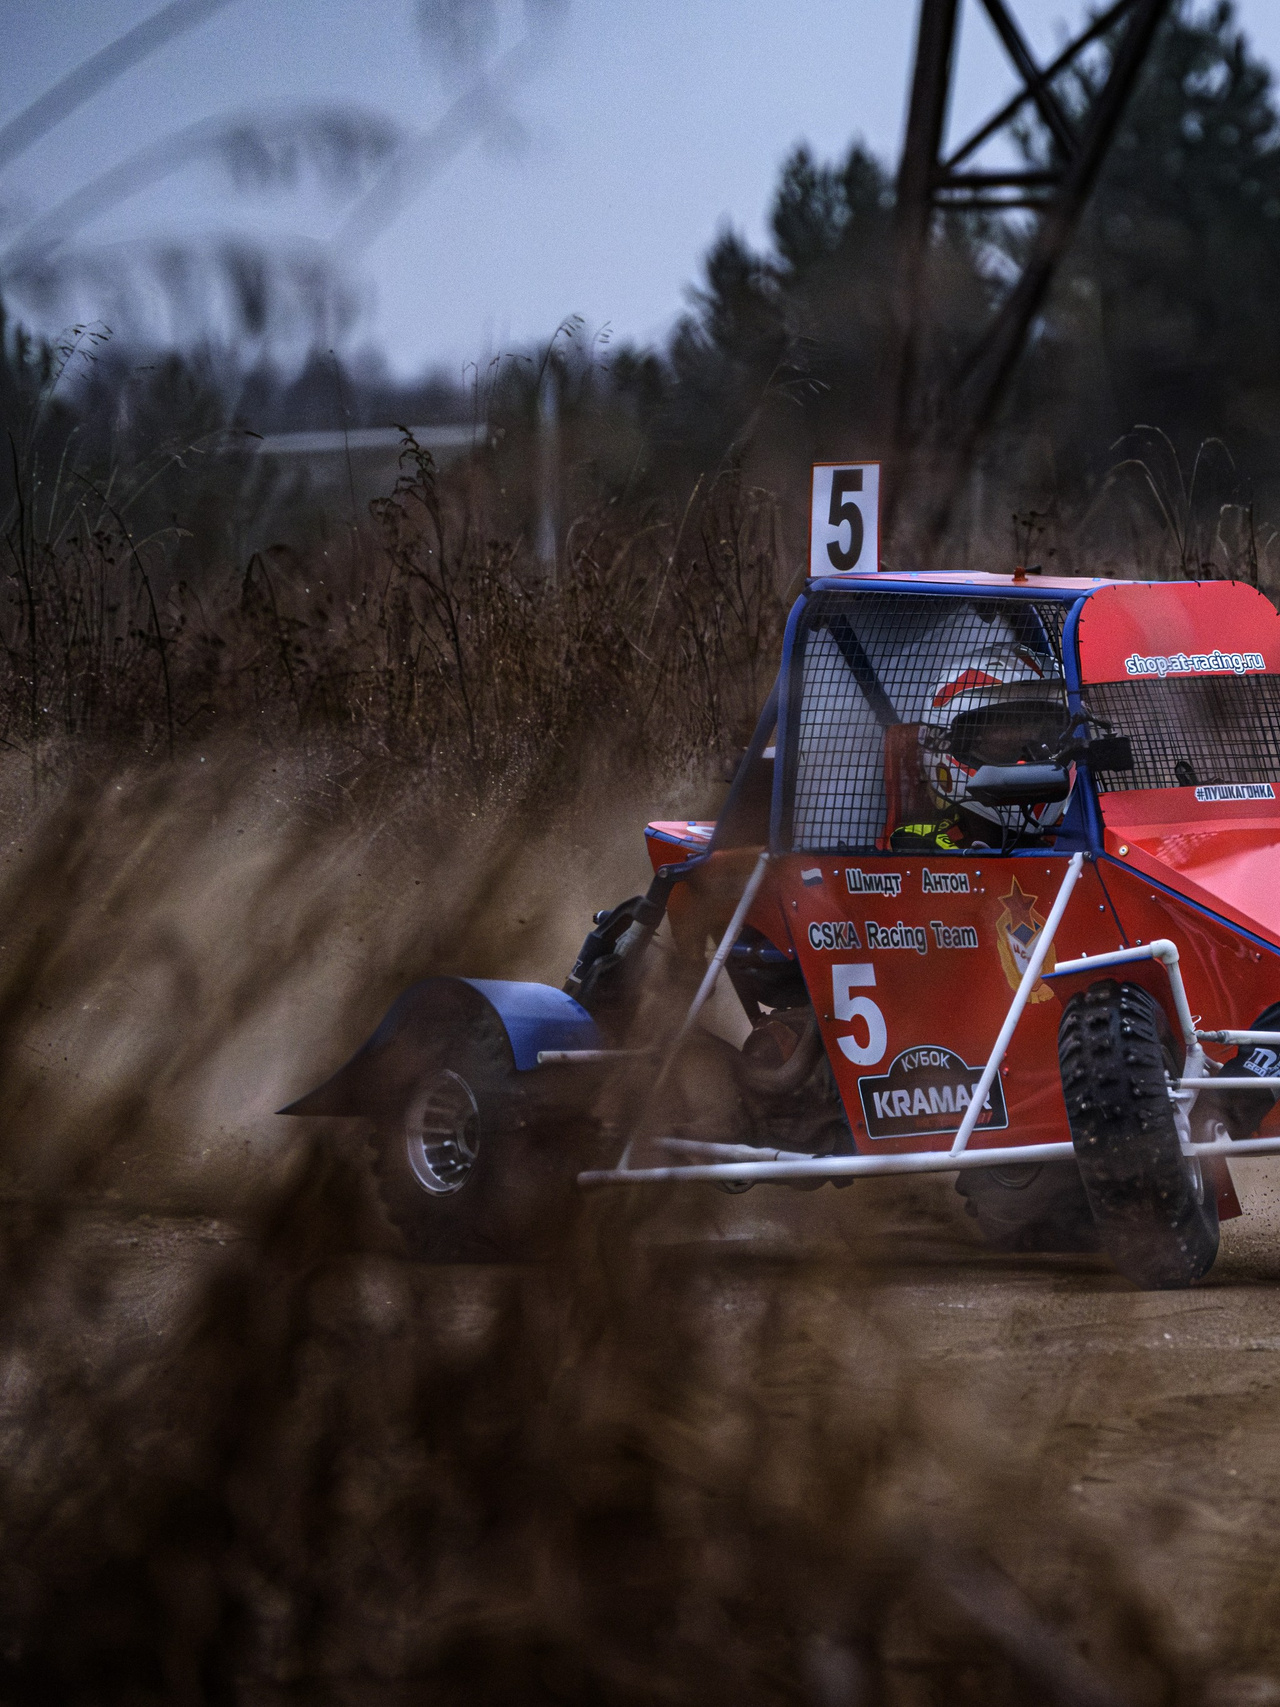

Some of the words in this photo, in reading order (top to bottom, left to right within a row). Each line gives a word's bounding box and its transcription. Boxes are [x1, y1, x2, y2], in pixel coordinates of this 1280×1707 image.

[826, 468, 864, 571] 5
[1126, 650, 1265, 677] shop.at-racing.ru
[1196, 785, 1274, 800] #ПУШКАГОНКА
[846, 868, 901, 897] Шмидт
[922, 868, 970, 893] Антон
[808, 922, 861, 949] CSKA
[865, 921, 927, 954] Racing
[930, 921, 978, 948] Team
[832, 962, 887, 1066] 5
[901, 1050, 950, 1072] КУБОК
